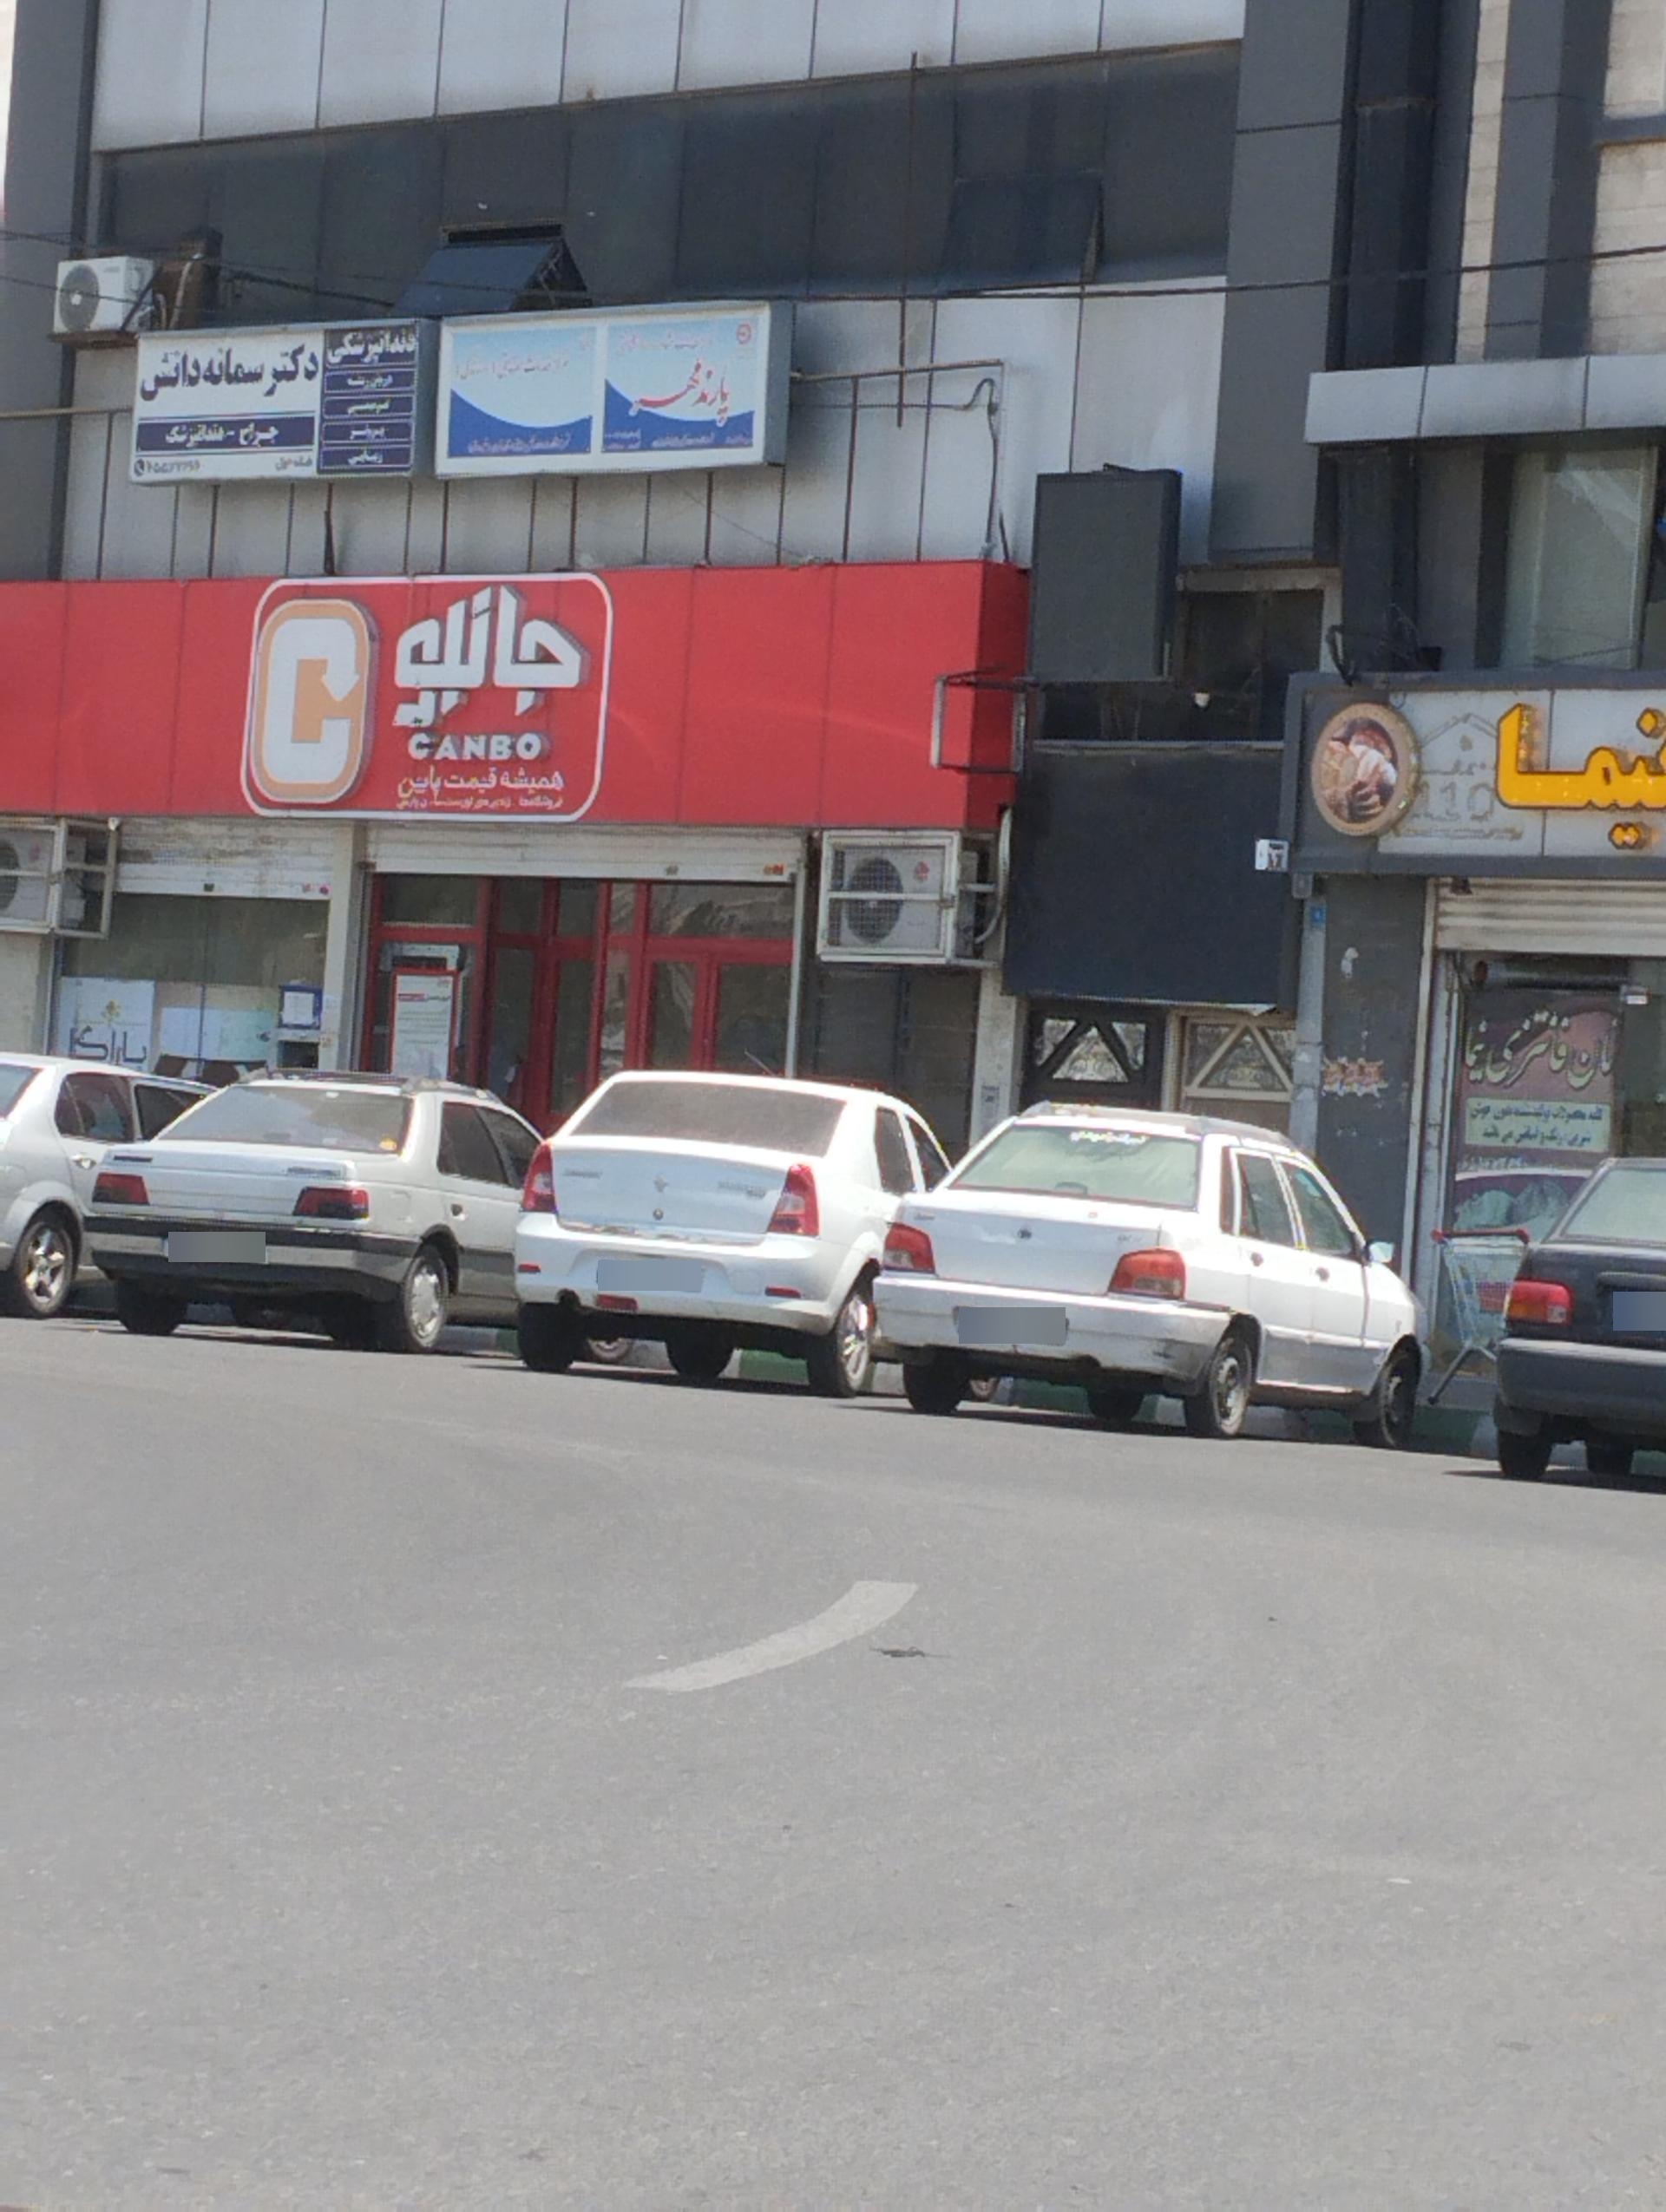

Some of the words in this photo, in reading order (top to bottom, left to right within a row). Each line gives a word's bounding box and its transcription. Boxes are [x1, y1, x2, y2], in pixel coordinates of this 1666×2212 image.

[141, 350, 201, 401] دانش
[203, 348, 264, 385] سمانه
[264, 344, 318, 396] دکتر
[239, 421, 279, 447] جراح
[392, 584, 582, 728] جانبو
[408, 733, 543, 761] CANBO
[444, 767, 498, 794] قیمت
[500, 767, 564, 794] همیشه
